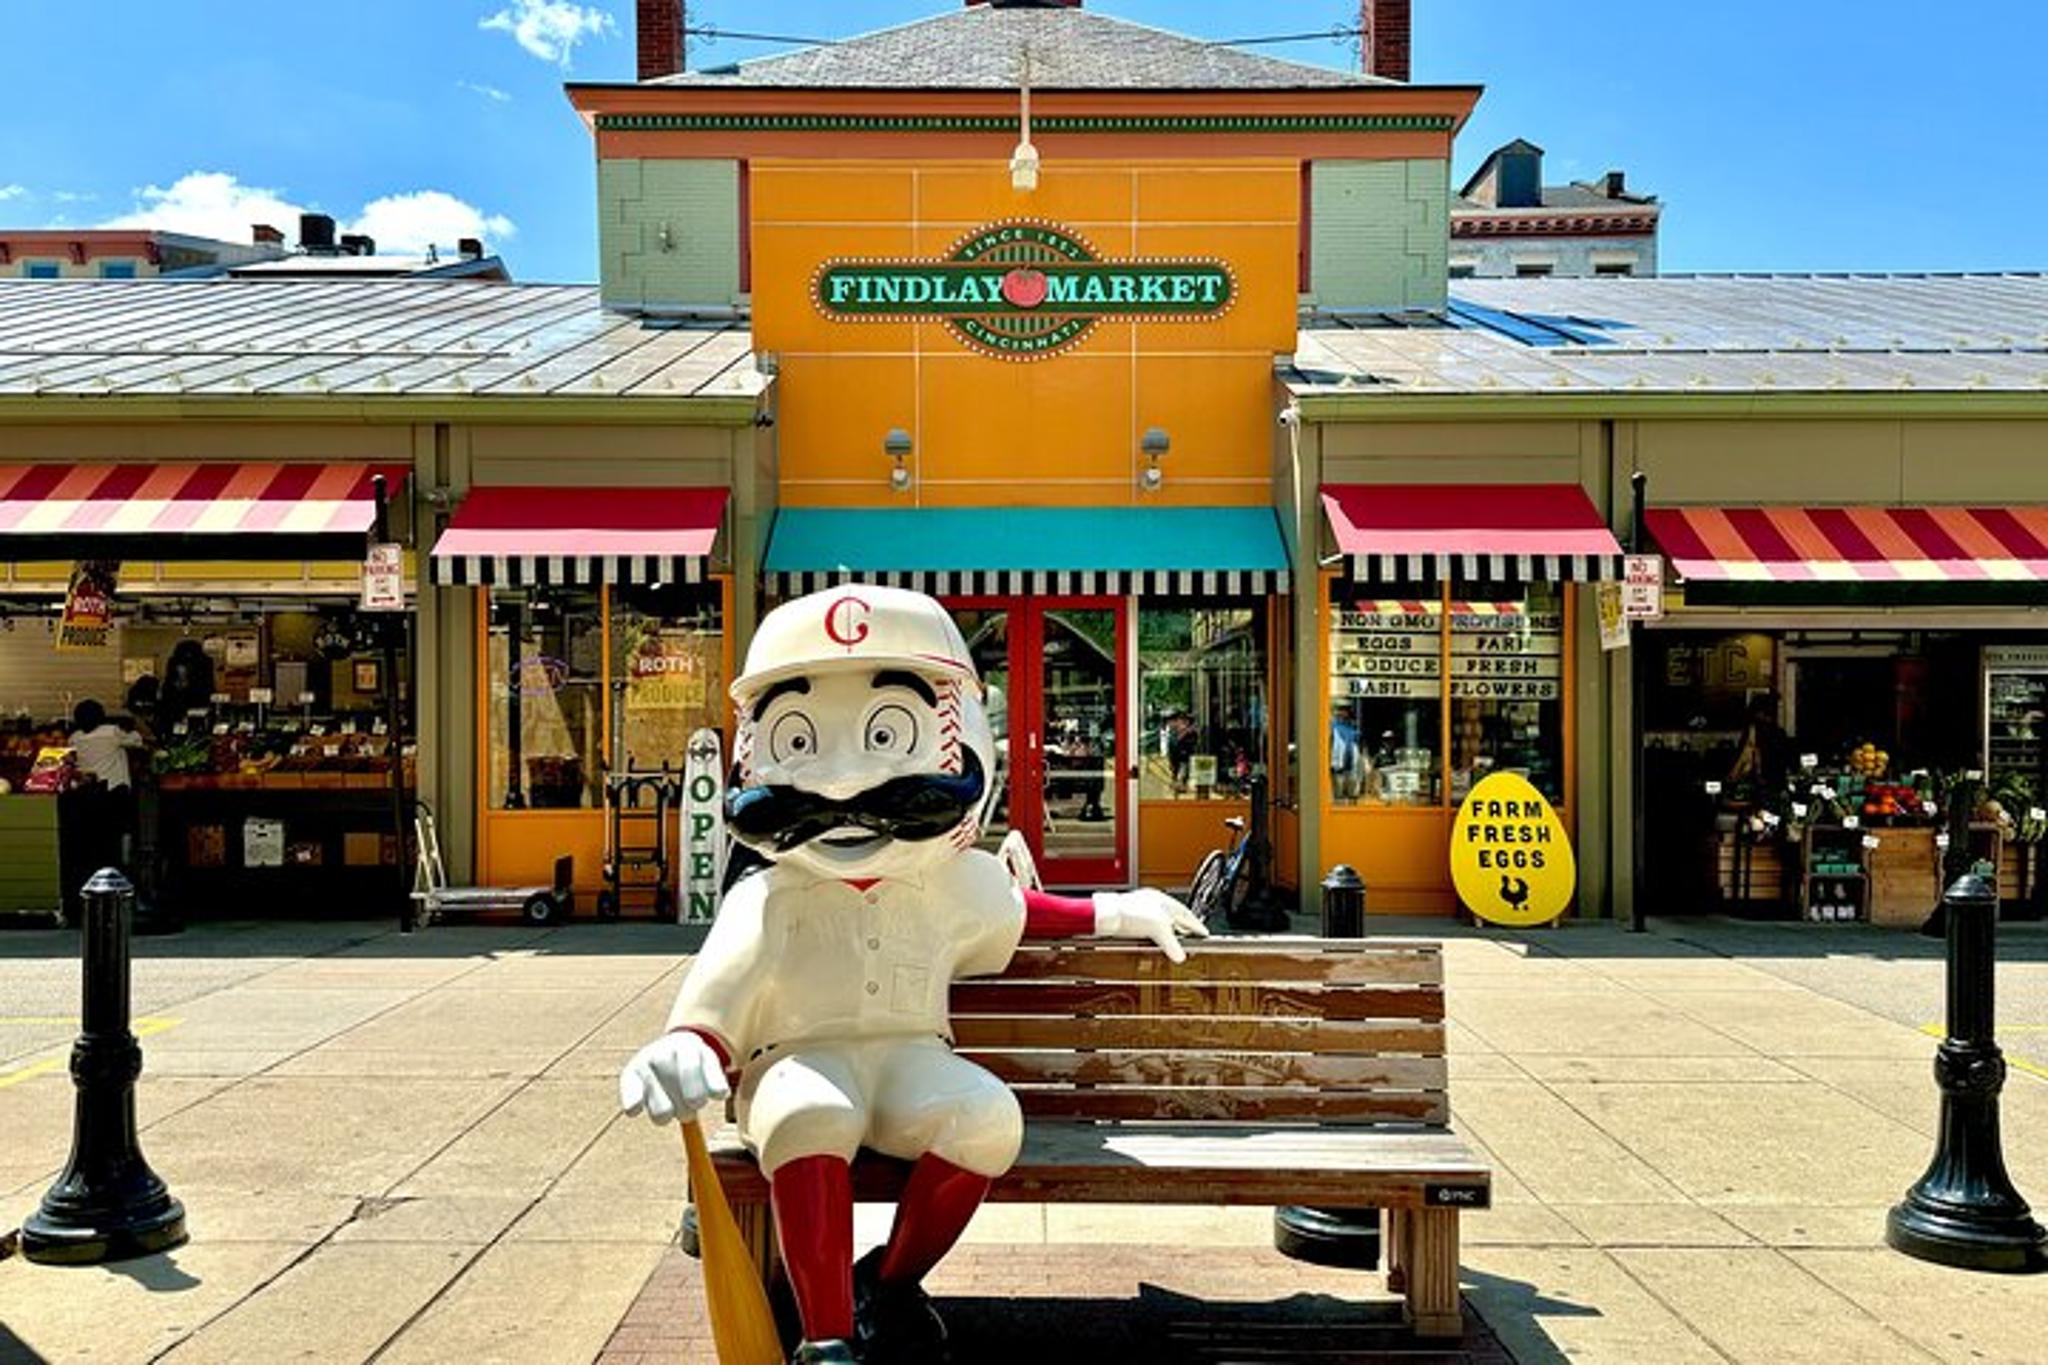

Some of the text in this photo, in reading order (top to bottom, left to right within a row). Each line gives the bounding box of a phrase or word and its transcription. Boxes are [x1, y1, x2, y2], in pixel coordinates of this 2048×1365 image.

[964, 229, 1023, 258] SINCE
[830, 275, 1222, 302] FINDLAY MARKET
[966, 320, 1079, 350] CINCINNATI
[1390, 614, 1435, 629] GMO
[1357, 636, 1412, 650] EGGS
[1467, 659, 1538, 673] FRESH
[1349, 681, 1412, 695] BASIL
[1451, 682, 1553, 696] FLOWERS
[1472, 801, 1543, 818] FARM
[1467, 825, 1552, 842] FRESH
[688, 774, 717, 919] OPEN
[1478, 850, 1545, 868] EGGS
